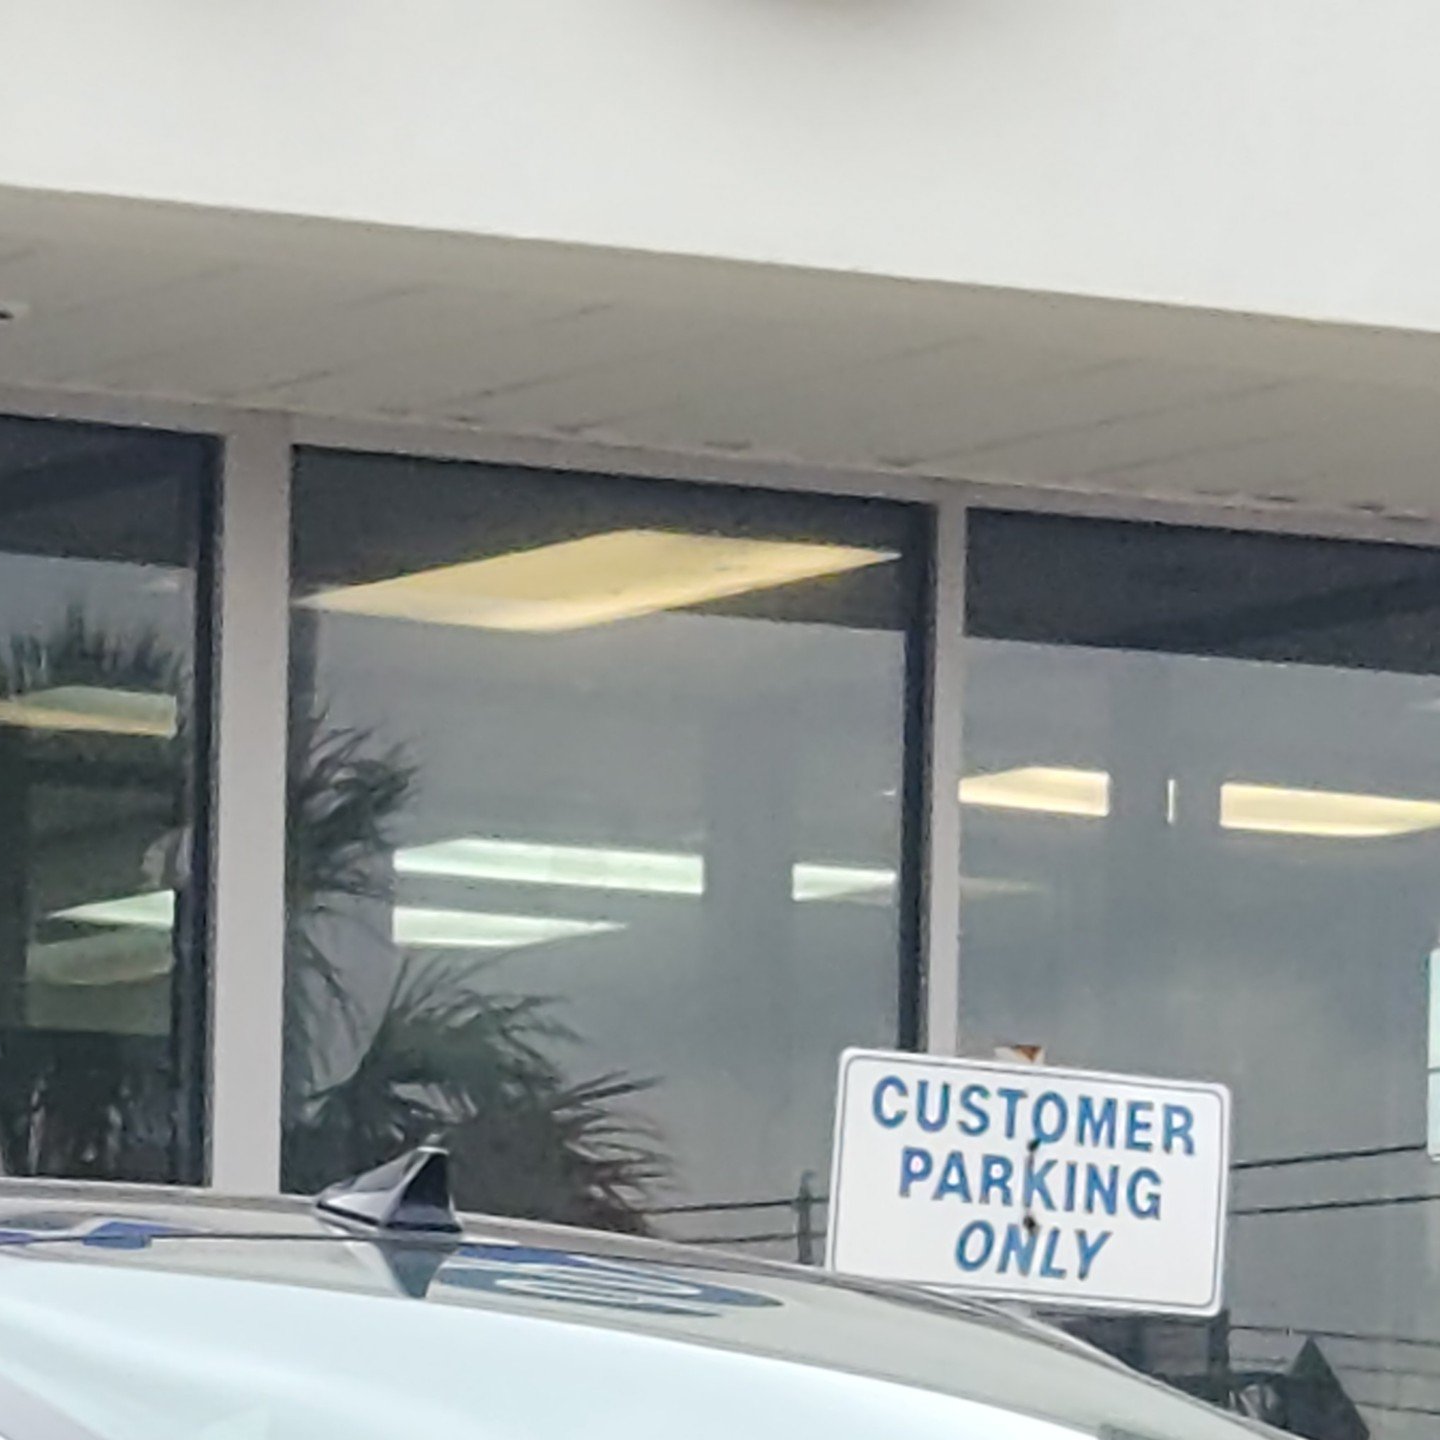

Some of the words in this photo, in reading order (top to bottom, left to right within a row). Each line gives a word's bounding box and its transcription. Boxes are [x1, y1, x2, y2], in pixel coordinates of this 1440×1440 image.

[871, 1075, 1196, 1156] CUSTOMER
[897, 1146, 1162, 1221] PARKING
[954, 1219, 1113, 1281] ONLY
